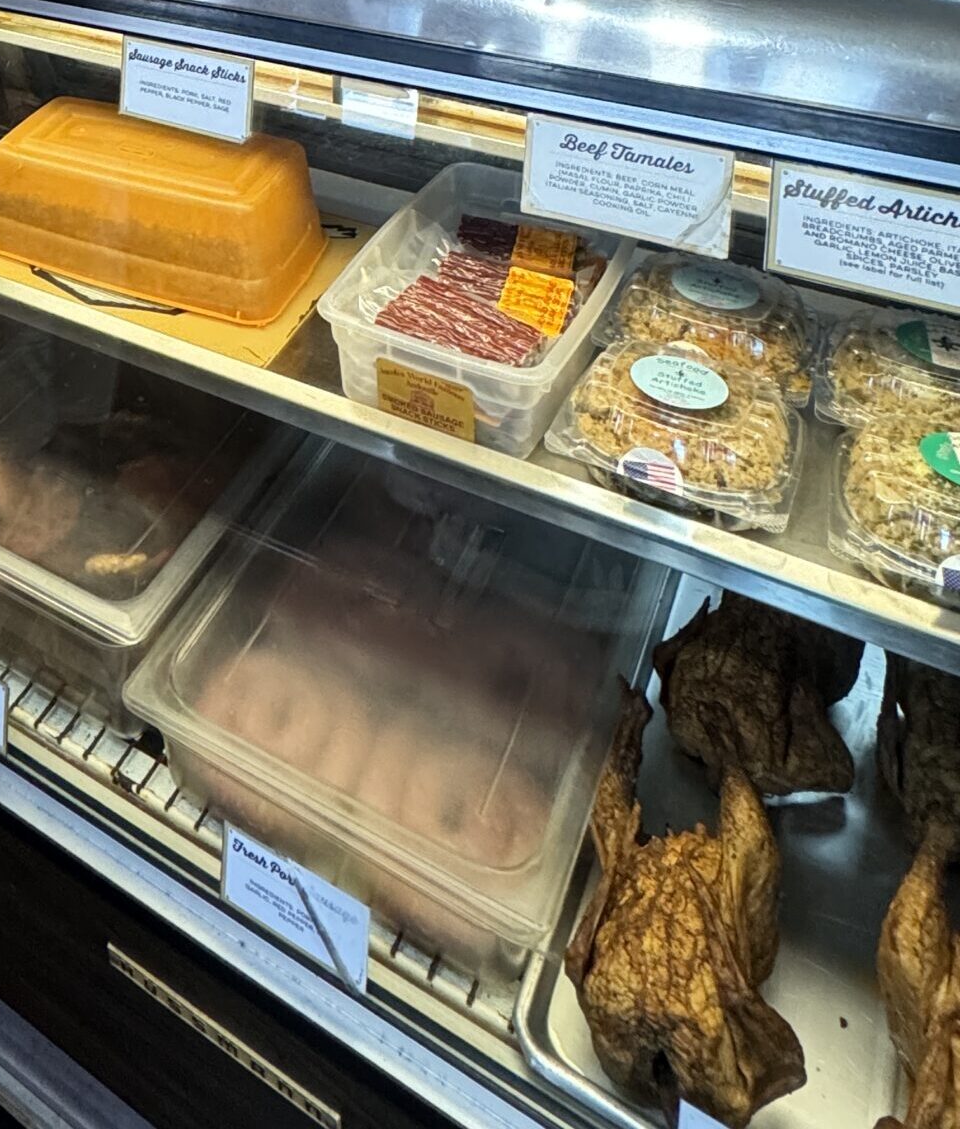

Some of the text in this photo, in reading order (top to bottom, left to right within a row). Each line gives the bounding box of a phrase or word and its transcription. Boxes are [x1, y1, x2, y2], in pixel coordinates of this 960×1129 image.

[128, 49, 246, 83] Sausage Snack Sticks
[559, 133, 695, 174] Beef Tamales
[593, 198, 633, 213] COOKING
[783, 179, 960, 229] Stuffed Artich
[859, 249, 897, 263] LEMON
[889, 263, 938, 280] PARSLEY
[232, 838, 297, 886] Fresh Por
